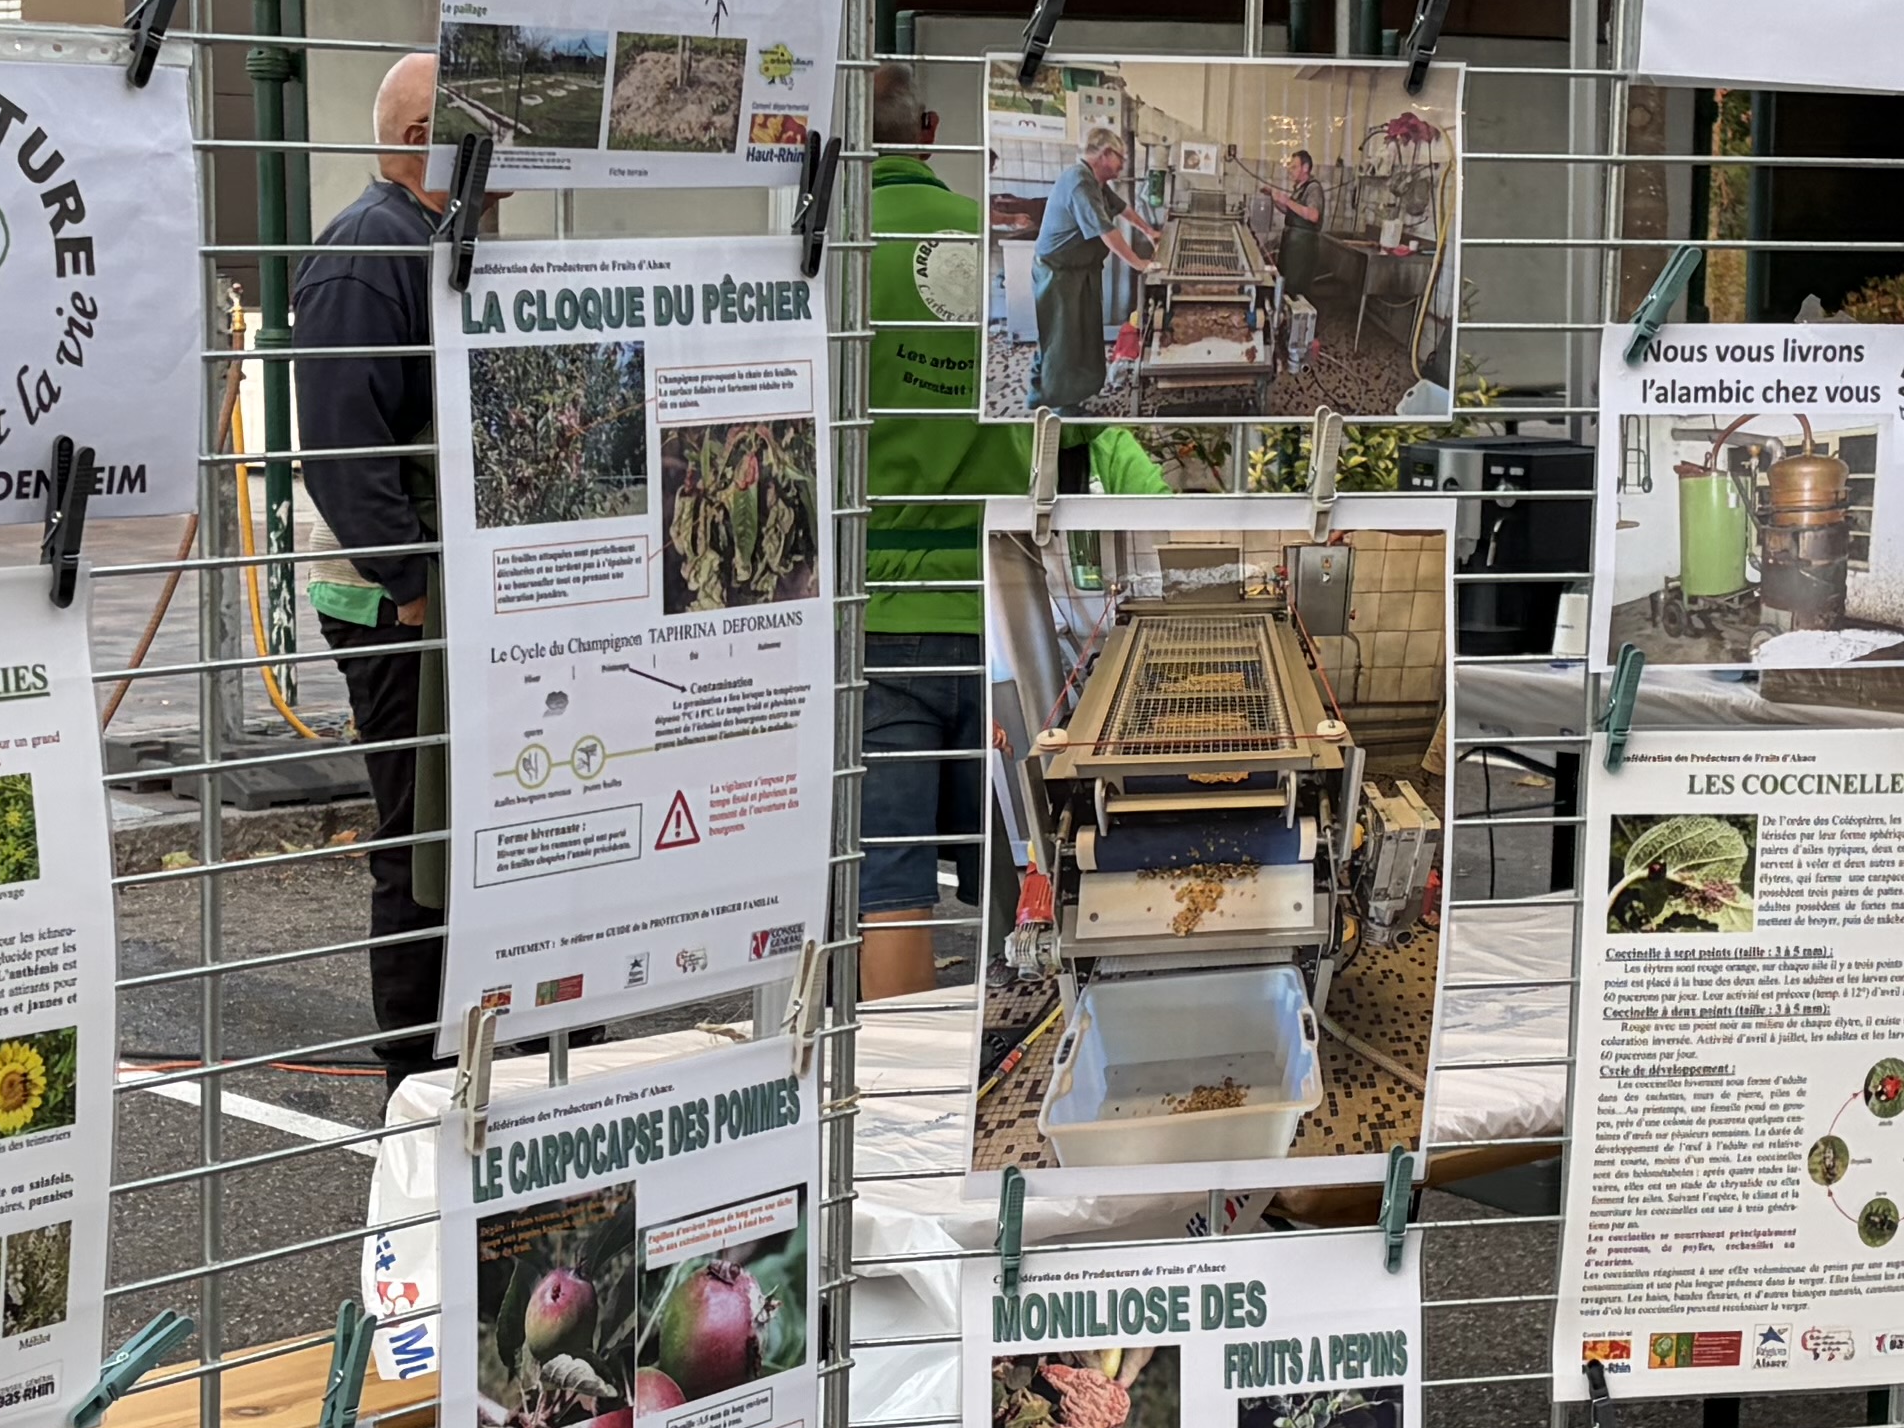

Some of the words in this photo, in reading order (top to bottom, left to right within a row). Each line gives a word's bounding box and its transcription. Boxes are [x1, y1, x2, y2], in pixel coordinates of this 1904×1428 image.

[458, 285, 507, 335] LA
[513, 286, 646, 333] CLOQUE
[653, 284, 694, 327] DU
[702, 270, 815, 325] PÊCHER
[1640, 336, 1708, 365] Nous
[1715, 344, 1775, 363] vous
[1783, 338, 1865, 363] livrons
[1642, 378, 1754, 404] l'alambic
[1761, 378, 1818, 403] chez
[1824, 385, 1881, 403] vous
[1687, 774, 1735, 795] LES
[471, 1145, 504, 1204] LE
[507, 1108, 665, 1193] CARPOCAPSE
[667, 1099, 710, 1157] DES
[713, 1074, 802, 1144] POMMES
[992, 1285, 1191, 1344] MONILIOSE
[1200, 1279, 1267, 1331] DES
[1224, 1337, 1304, 1390] FRUITS
[1307, 1336, 1325, 1383] A
[1328, 1329, 1408, 1381] PEPINS
